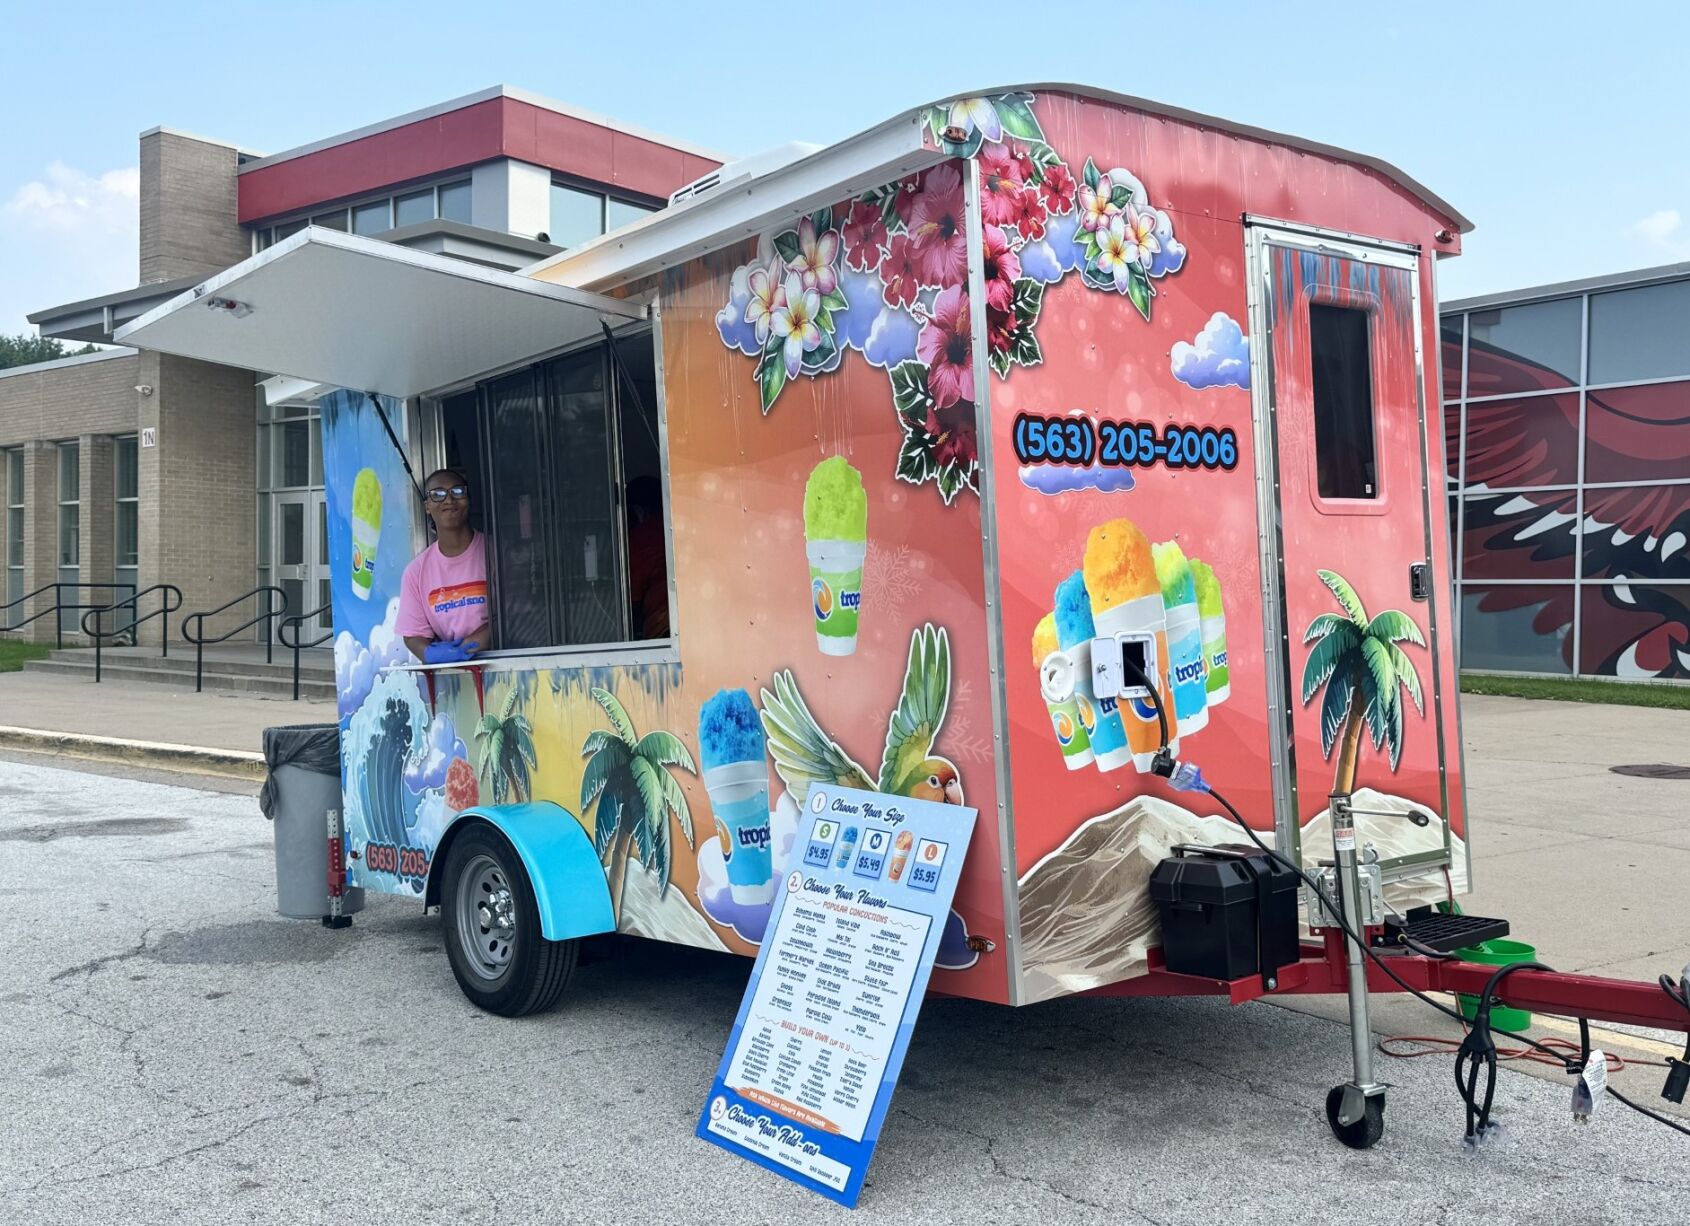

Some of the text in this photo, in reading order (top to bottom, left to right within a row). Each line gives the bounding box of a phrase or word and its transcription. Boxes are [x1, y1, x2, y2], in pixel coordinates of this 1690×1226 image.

[143, 430, 154, 446] 1N
[1017, 419, 1236, 465] (563) 205-2006
[466, 596, 486, 605] sno
[831, 798, 905, 827] Choose Your Size
[366, 844, 398, 873] (563)
[808, 845, 829, 860] $4.95
[858, 856, 880, 872] $5.49
[913, 867, 936, 884] $5.95
[803, 878, 886, 908] Choose Your Flavors
[823, 901, 888, 923] POPULAR CONCOCTIONS
[781, 1020, 796, 1031] BUILD
[798, 1027, 814, 1037] YOUR
[814, 1032, 829, 1042] OWN
[728, 1106, 820, 1156] Choose Your Add-ons
